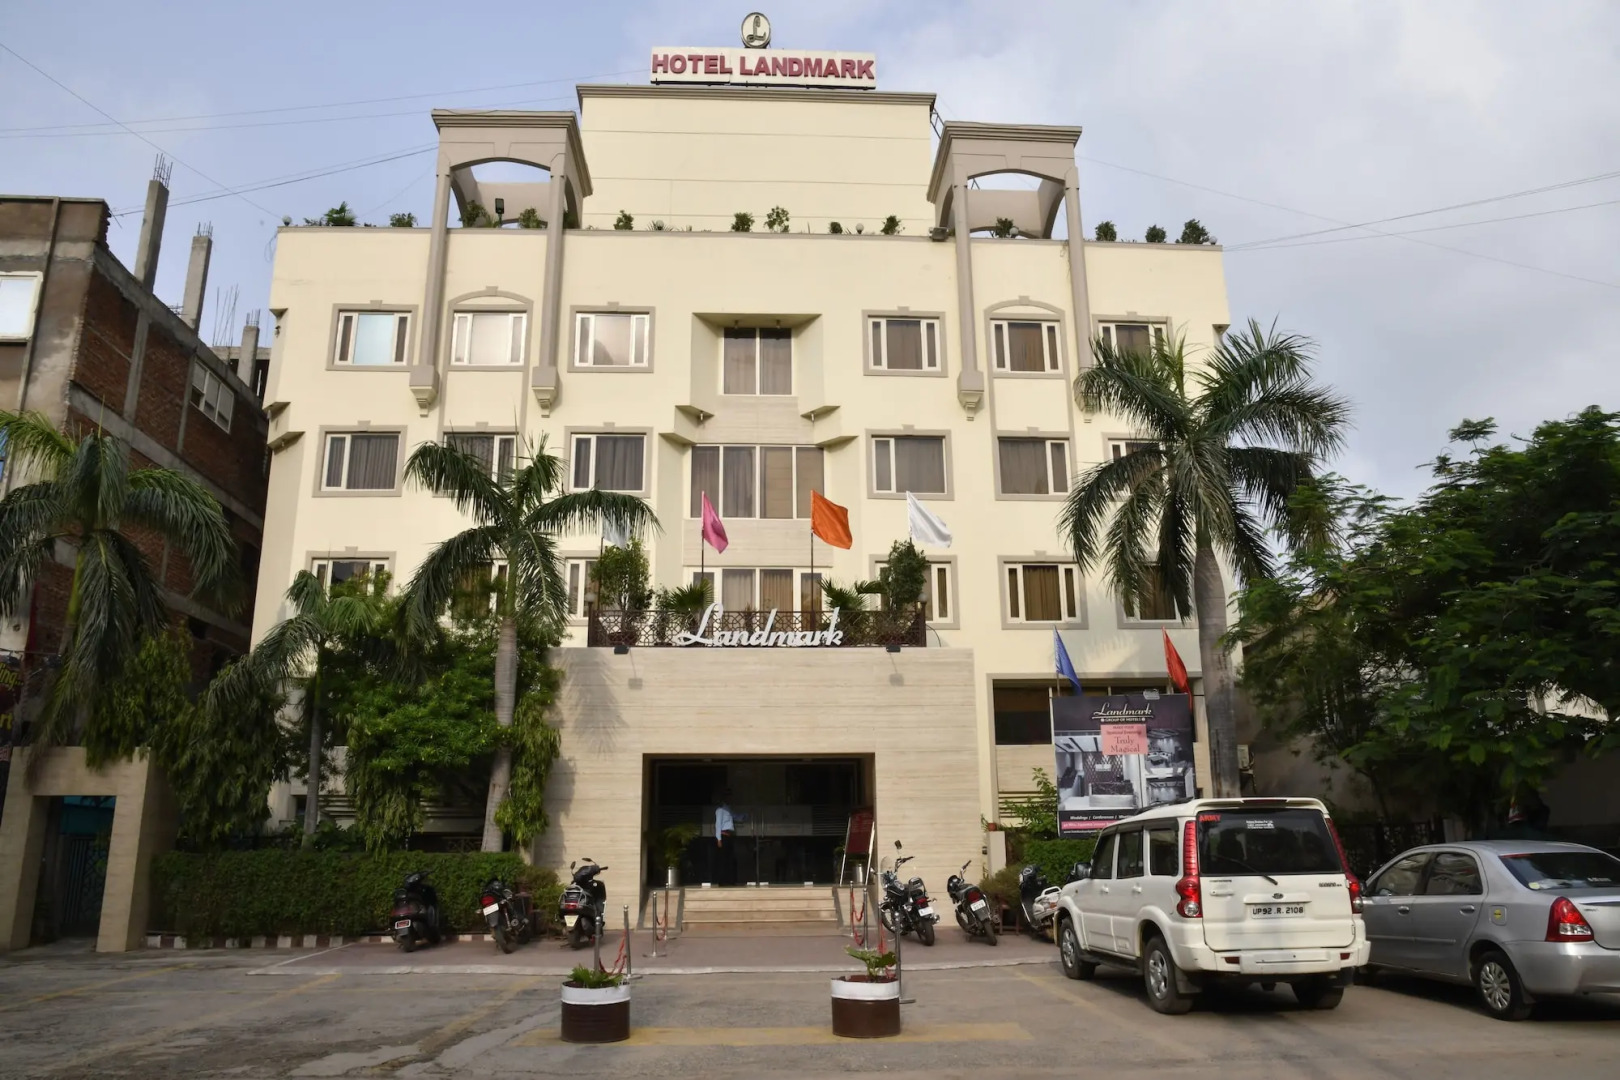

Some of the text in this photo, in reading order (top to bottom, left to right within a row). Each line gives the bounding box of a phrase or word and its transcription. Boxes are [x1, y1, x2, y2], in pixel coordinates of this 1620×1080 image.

[652, 54, 875, 79] HOTEL LANDMARK
[673, 602, 844, 647] Landmark
[1093, 702, 1152, 716] Landmark
[1114, 735, 1134, 745] Truly
[1111, 744, 1140, 752] Magical
[1199, 814, 1221, 822] ARMY
